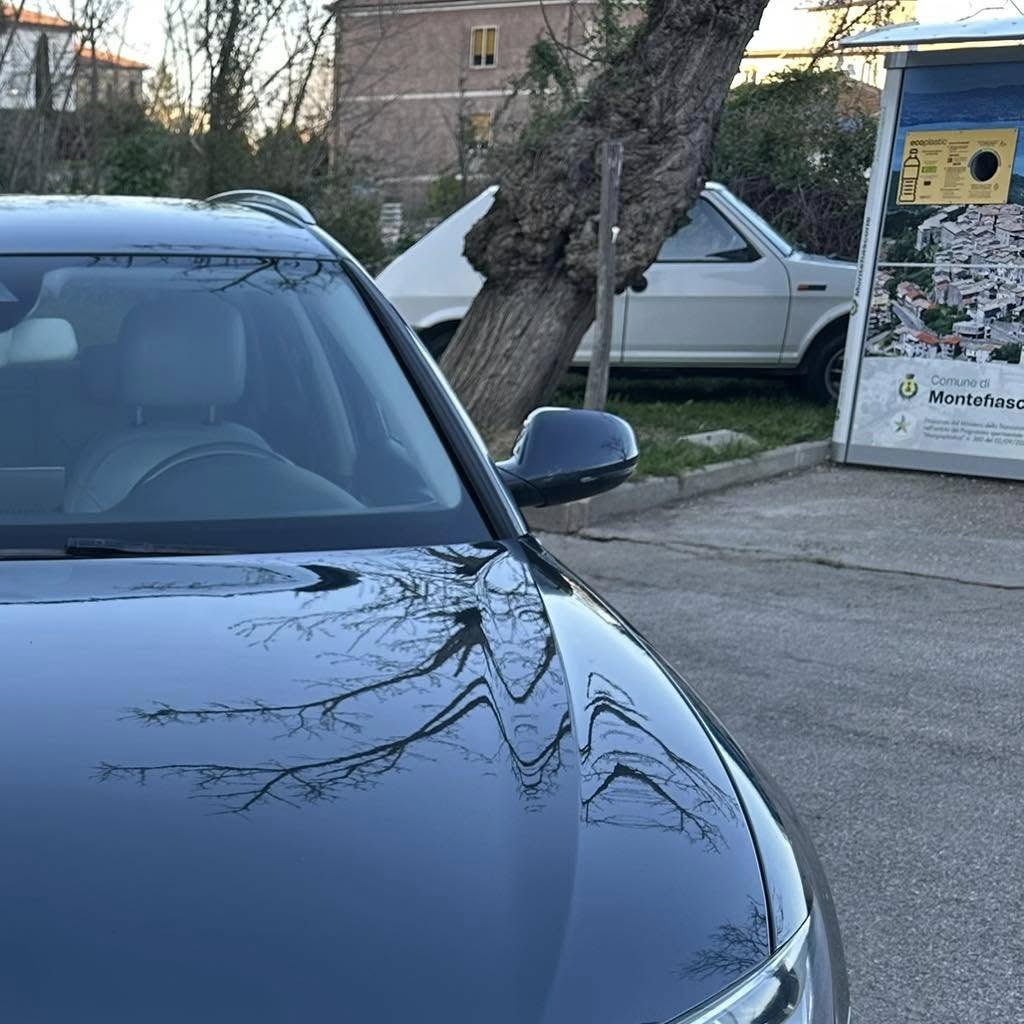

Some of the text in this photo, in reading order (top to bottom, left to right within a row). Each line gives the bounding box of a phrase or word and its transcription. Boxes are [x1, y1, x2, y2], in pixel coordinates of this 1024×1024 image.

[931, 374, 990, 389] Comune di
[928, 390, 1024, 410] Montefiasc
